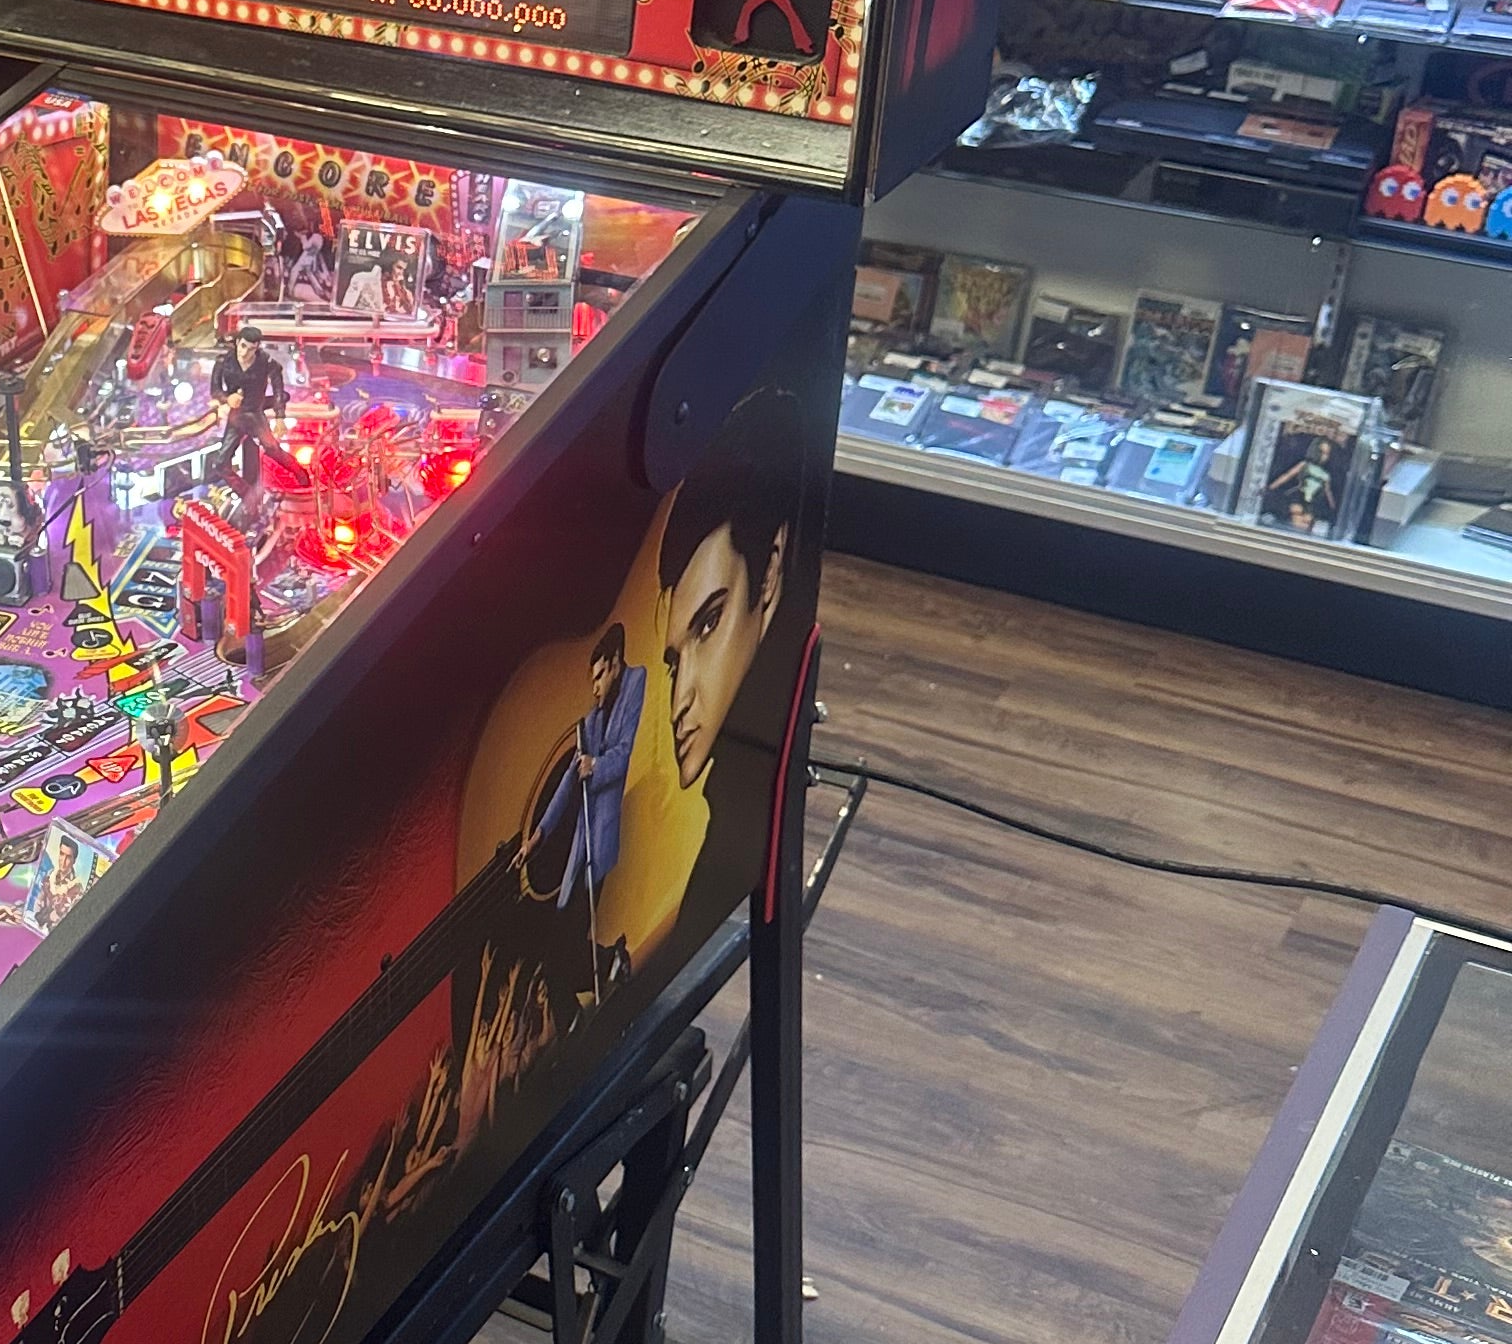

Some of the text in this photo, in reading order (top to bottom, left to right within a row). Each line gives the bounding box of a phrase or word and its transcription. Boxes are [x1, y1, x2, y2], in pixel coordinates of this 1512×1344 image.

[44, 95, 72, 110] USA
[109, 156, 222, 205] WELCOME
[184, 132, 438, 208] ENCORE
[122, 201, 160, 230] LAS
[167, 181, 229, 219] VEGAS
[152, 208, 201, 229] NEVADA
[347, 229, 418, 255] ELVIS
[194, 549, 226, 579] ROCK
